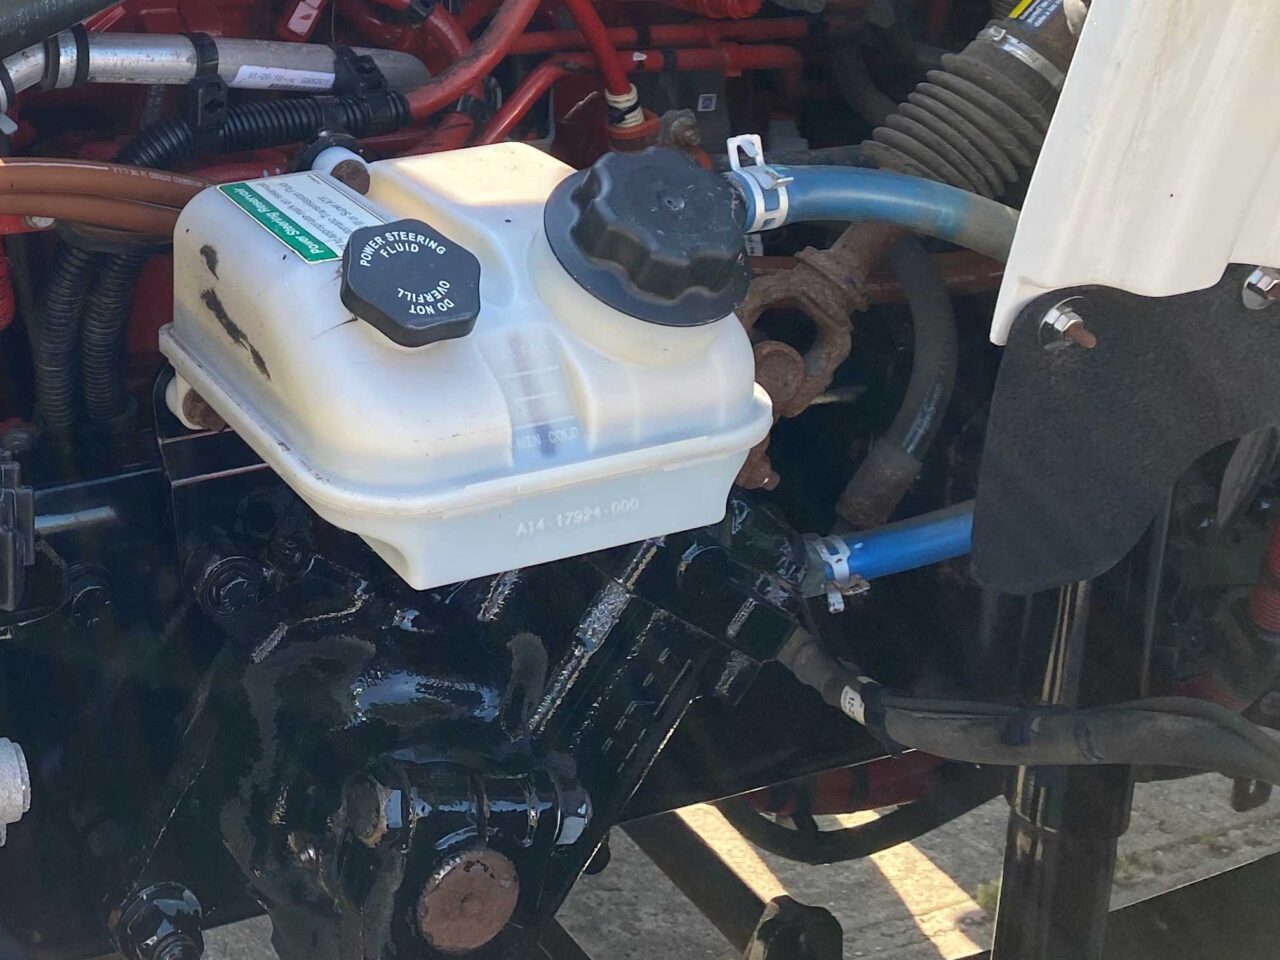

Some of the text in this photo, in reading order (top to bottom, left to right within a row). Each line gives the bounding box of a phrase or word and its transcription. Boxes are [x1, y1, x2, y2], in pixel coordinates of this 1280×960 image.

[266, 208, 299, 237] Steering
[297, 233, 324, 255] Power
[360, 231, 447, 267] POWER STEERING
[380, 242, 420, 258] FLUID
[397, 280, 450, 303] OVERFILL
[408, 298, 455, 315] DO NOT
